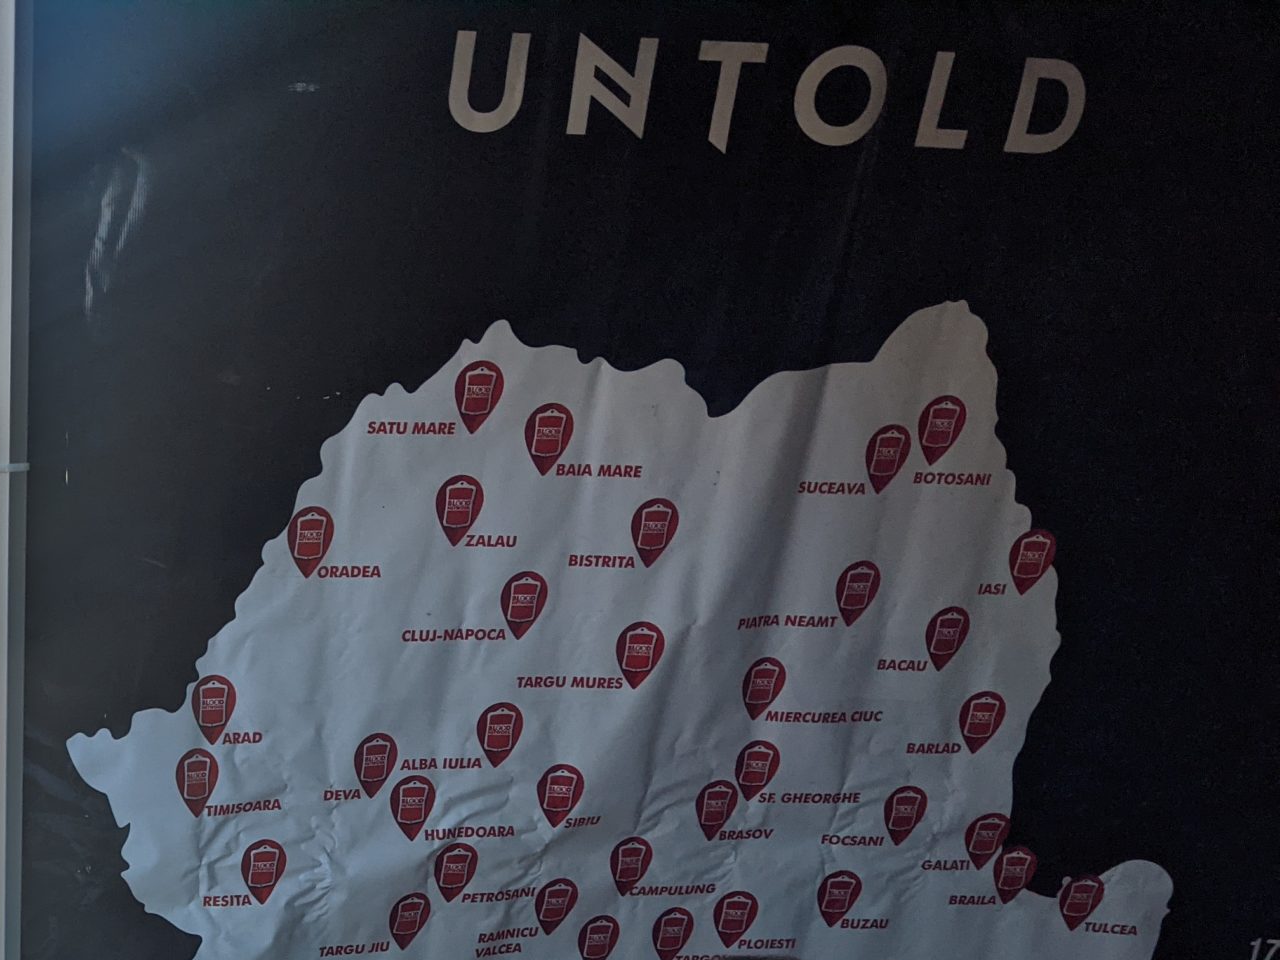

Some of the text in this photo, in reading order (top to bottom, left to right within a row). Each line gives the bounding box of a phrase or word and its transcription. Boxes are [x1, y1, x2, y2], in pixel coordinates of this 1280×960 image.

[448, 30, 1086, 154] UNTOLD
[368, 422, 456, 435] SATU MARE
[556, 464, 642, 478] BAIA MARE
[913, 472, 991, 486] BOTOSANI
[798, 482, 866, 495] SUCEAVA
[465, 535, 517, 548] ZALAU
[568, 555, 635, 568] BISTRITA
[317, 566, 381, 578] ORADEA
[978, 584, 1007, 595] IASI
[738, 614, 838, 630] PIATRA NEAMT
[402, 629, 506, 642] CLUJ-NAPOCA
[877, 659, 928, 672] BACAU
[517, 676, 623, 689] TARGU MURES
[766, 710, 882, 723] MIERCUREA CIUC
[222, 732, 262, 745] ARAD
[906, 743, 961, 754] BARLAD
[401, 757, 481, 771] ALBA IULIA
[324, 788, 361, 801] DEVA
[781, 792, 861, 804] GHEORGHE
[206, 799, 282, 817] TIMISOARA
[564, 816, 601, 829] SIBIU
[425, 826, 514, 841] HUNEDOARA
[719, 828, 774, 841] BRASOV
[821, 834, 884, 847] FOCSANI
[921, 859, 970, 871] GALATI
[462, 886, 536, 903] PETROSANI
[629, 884, 716, 897] CAMPULUNG
[203, 894, 252, 907] RESITA
[949, 895, 997, 906] BRAILA
[841, 919, 888, 929] BUZAU
[1084, 922, 1137, 935] TULCEA
[478, 927, 538, 944] RAMNICU
[320, 942, 389, 957] TARGU JIU
[475, 943, 522, 958] VALCEA
[738, 938, 796, 950] PLOIESTI
